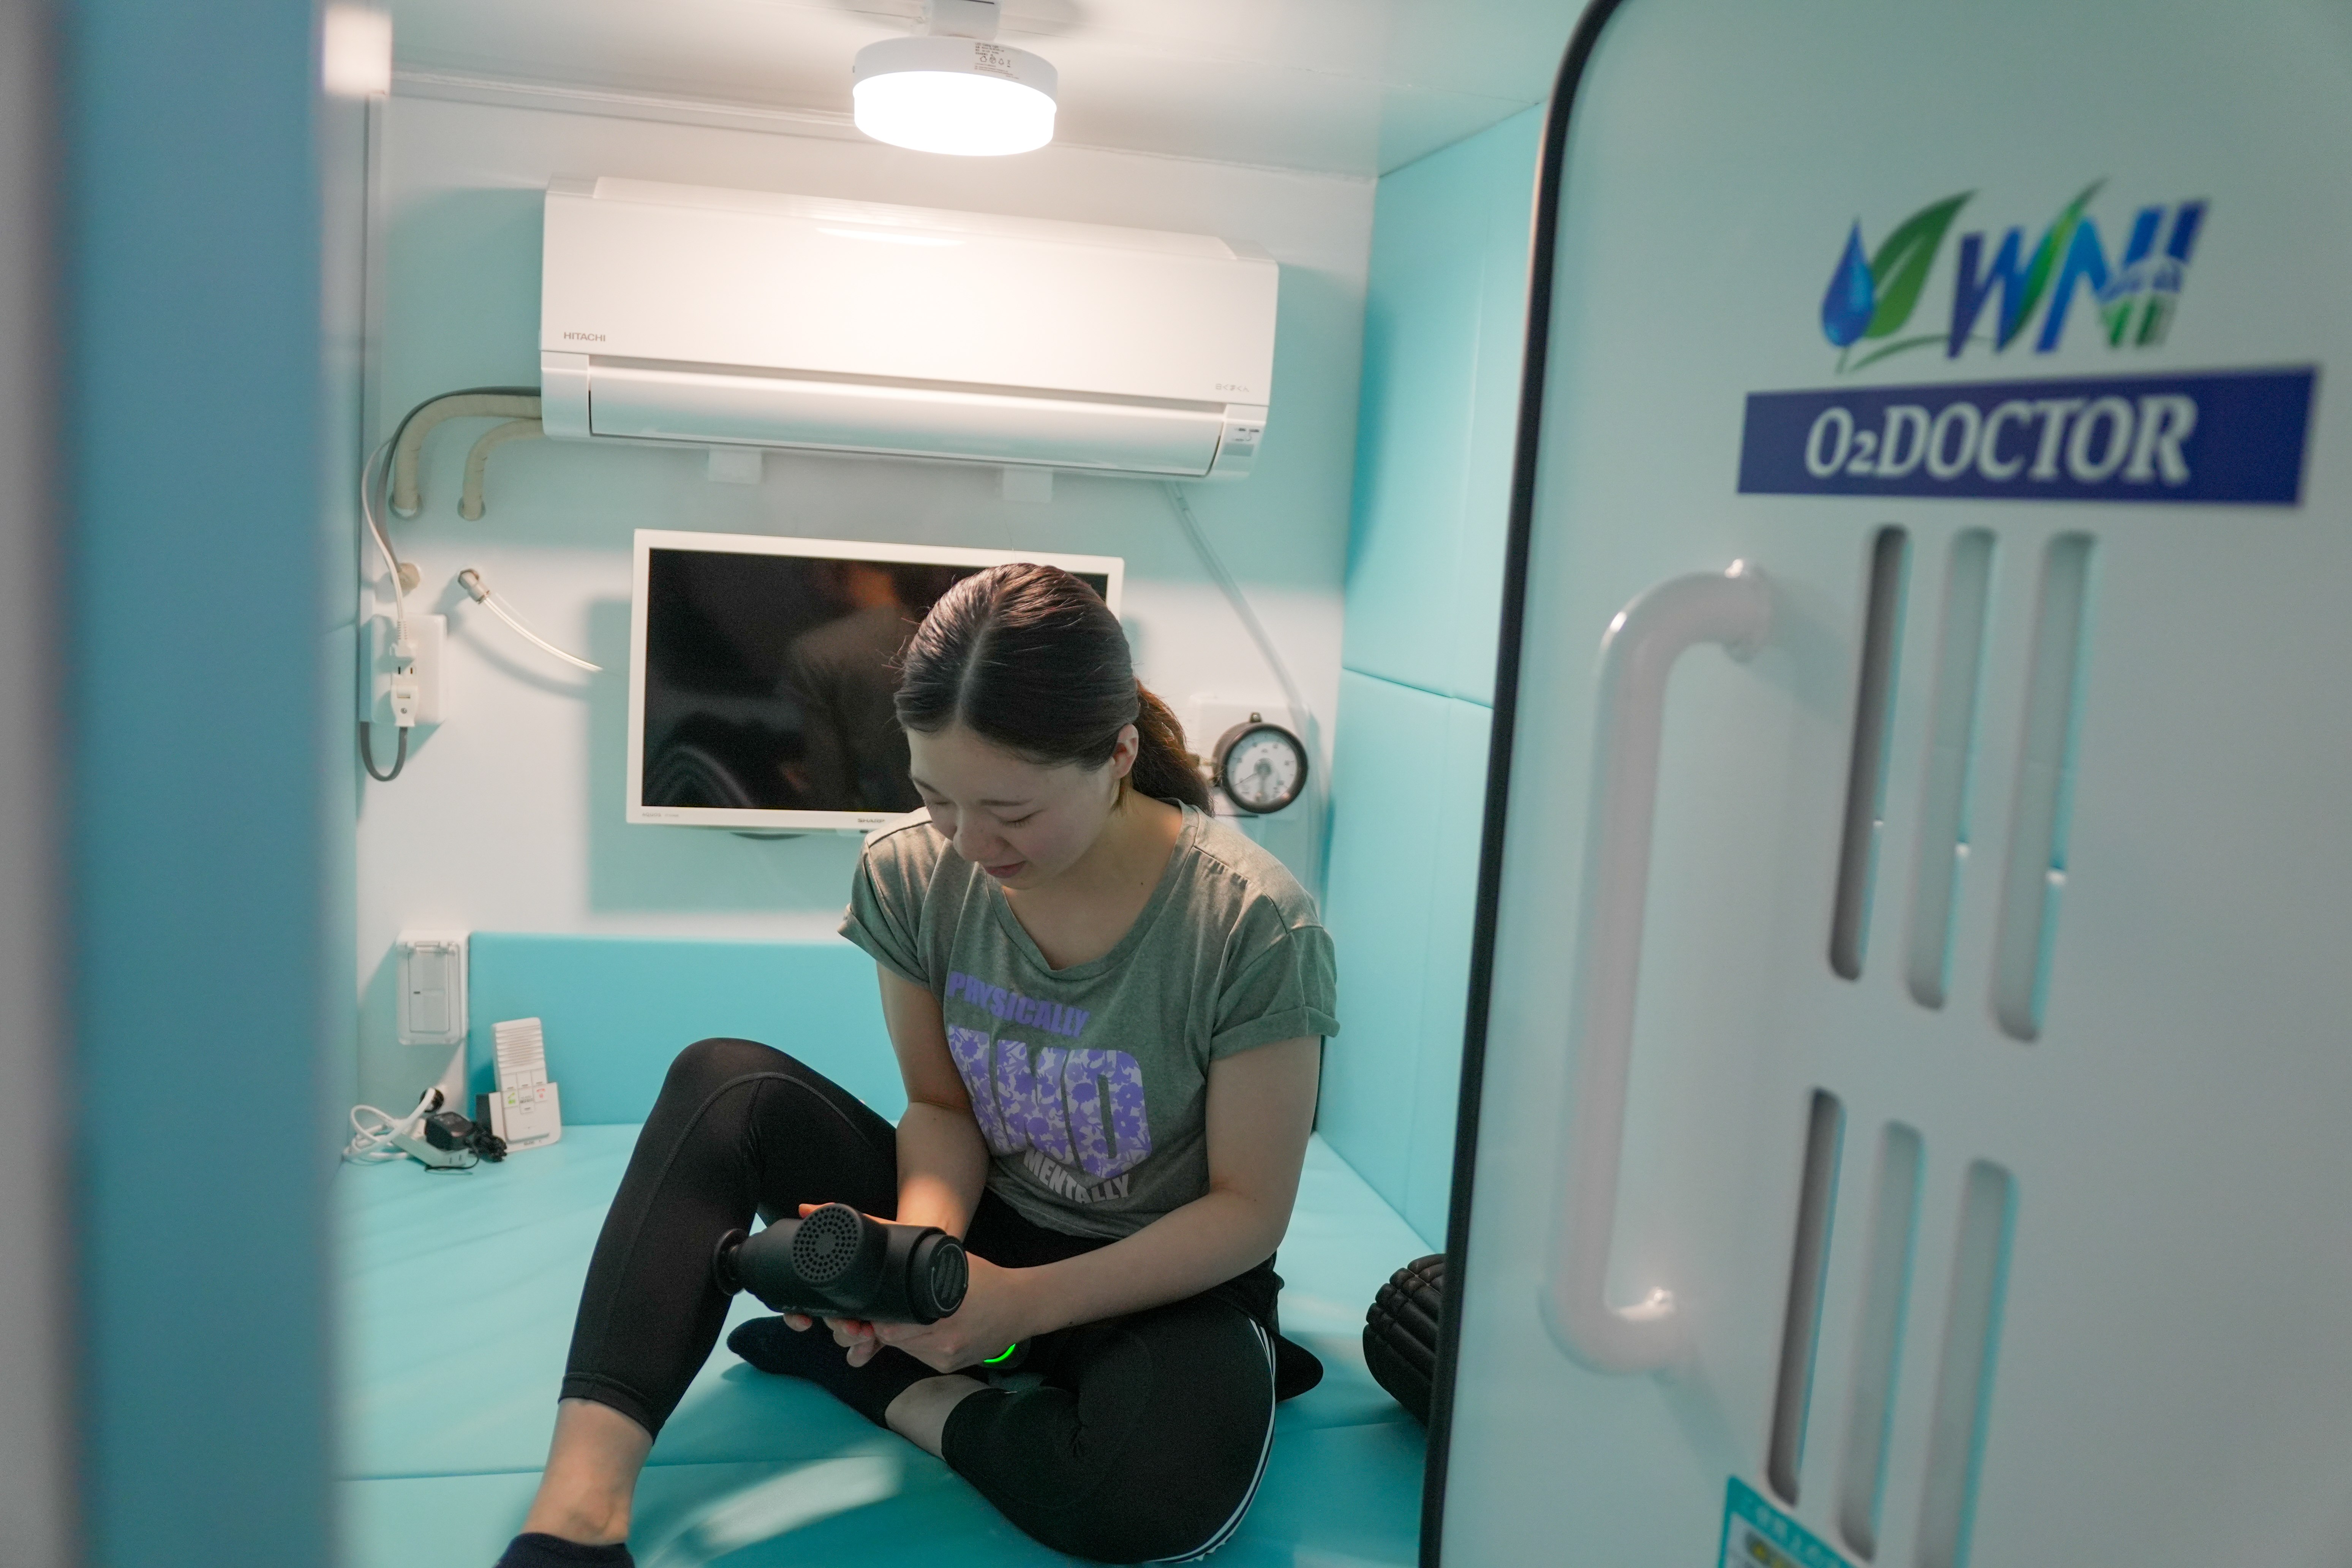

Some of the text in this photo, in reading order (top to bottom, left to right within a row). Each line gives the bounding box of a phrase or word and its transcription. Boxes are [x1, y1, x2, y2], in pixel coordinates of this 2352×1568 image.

[564, 332, 606, 341] HITACHI
[947, 971, 1091, 1038] PHYSICALLY
[1023, 1147, 1130, 1204] MENTALLY
